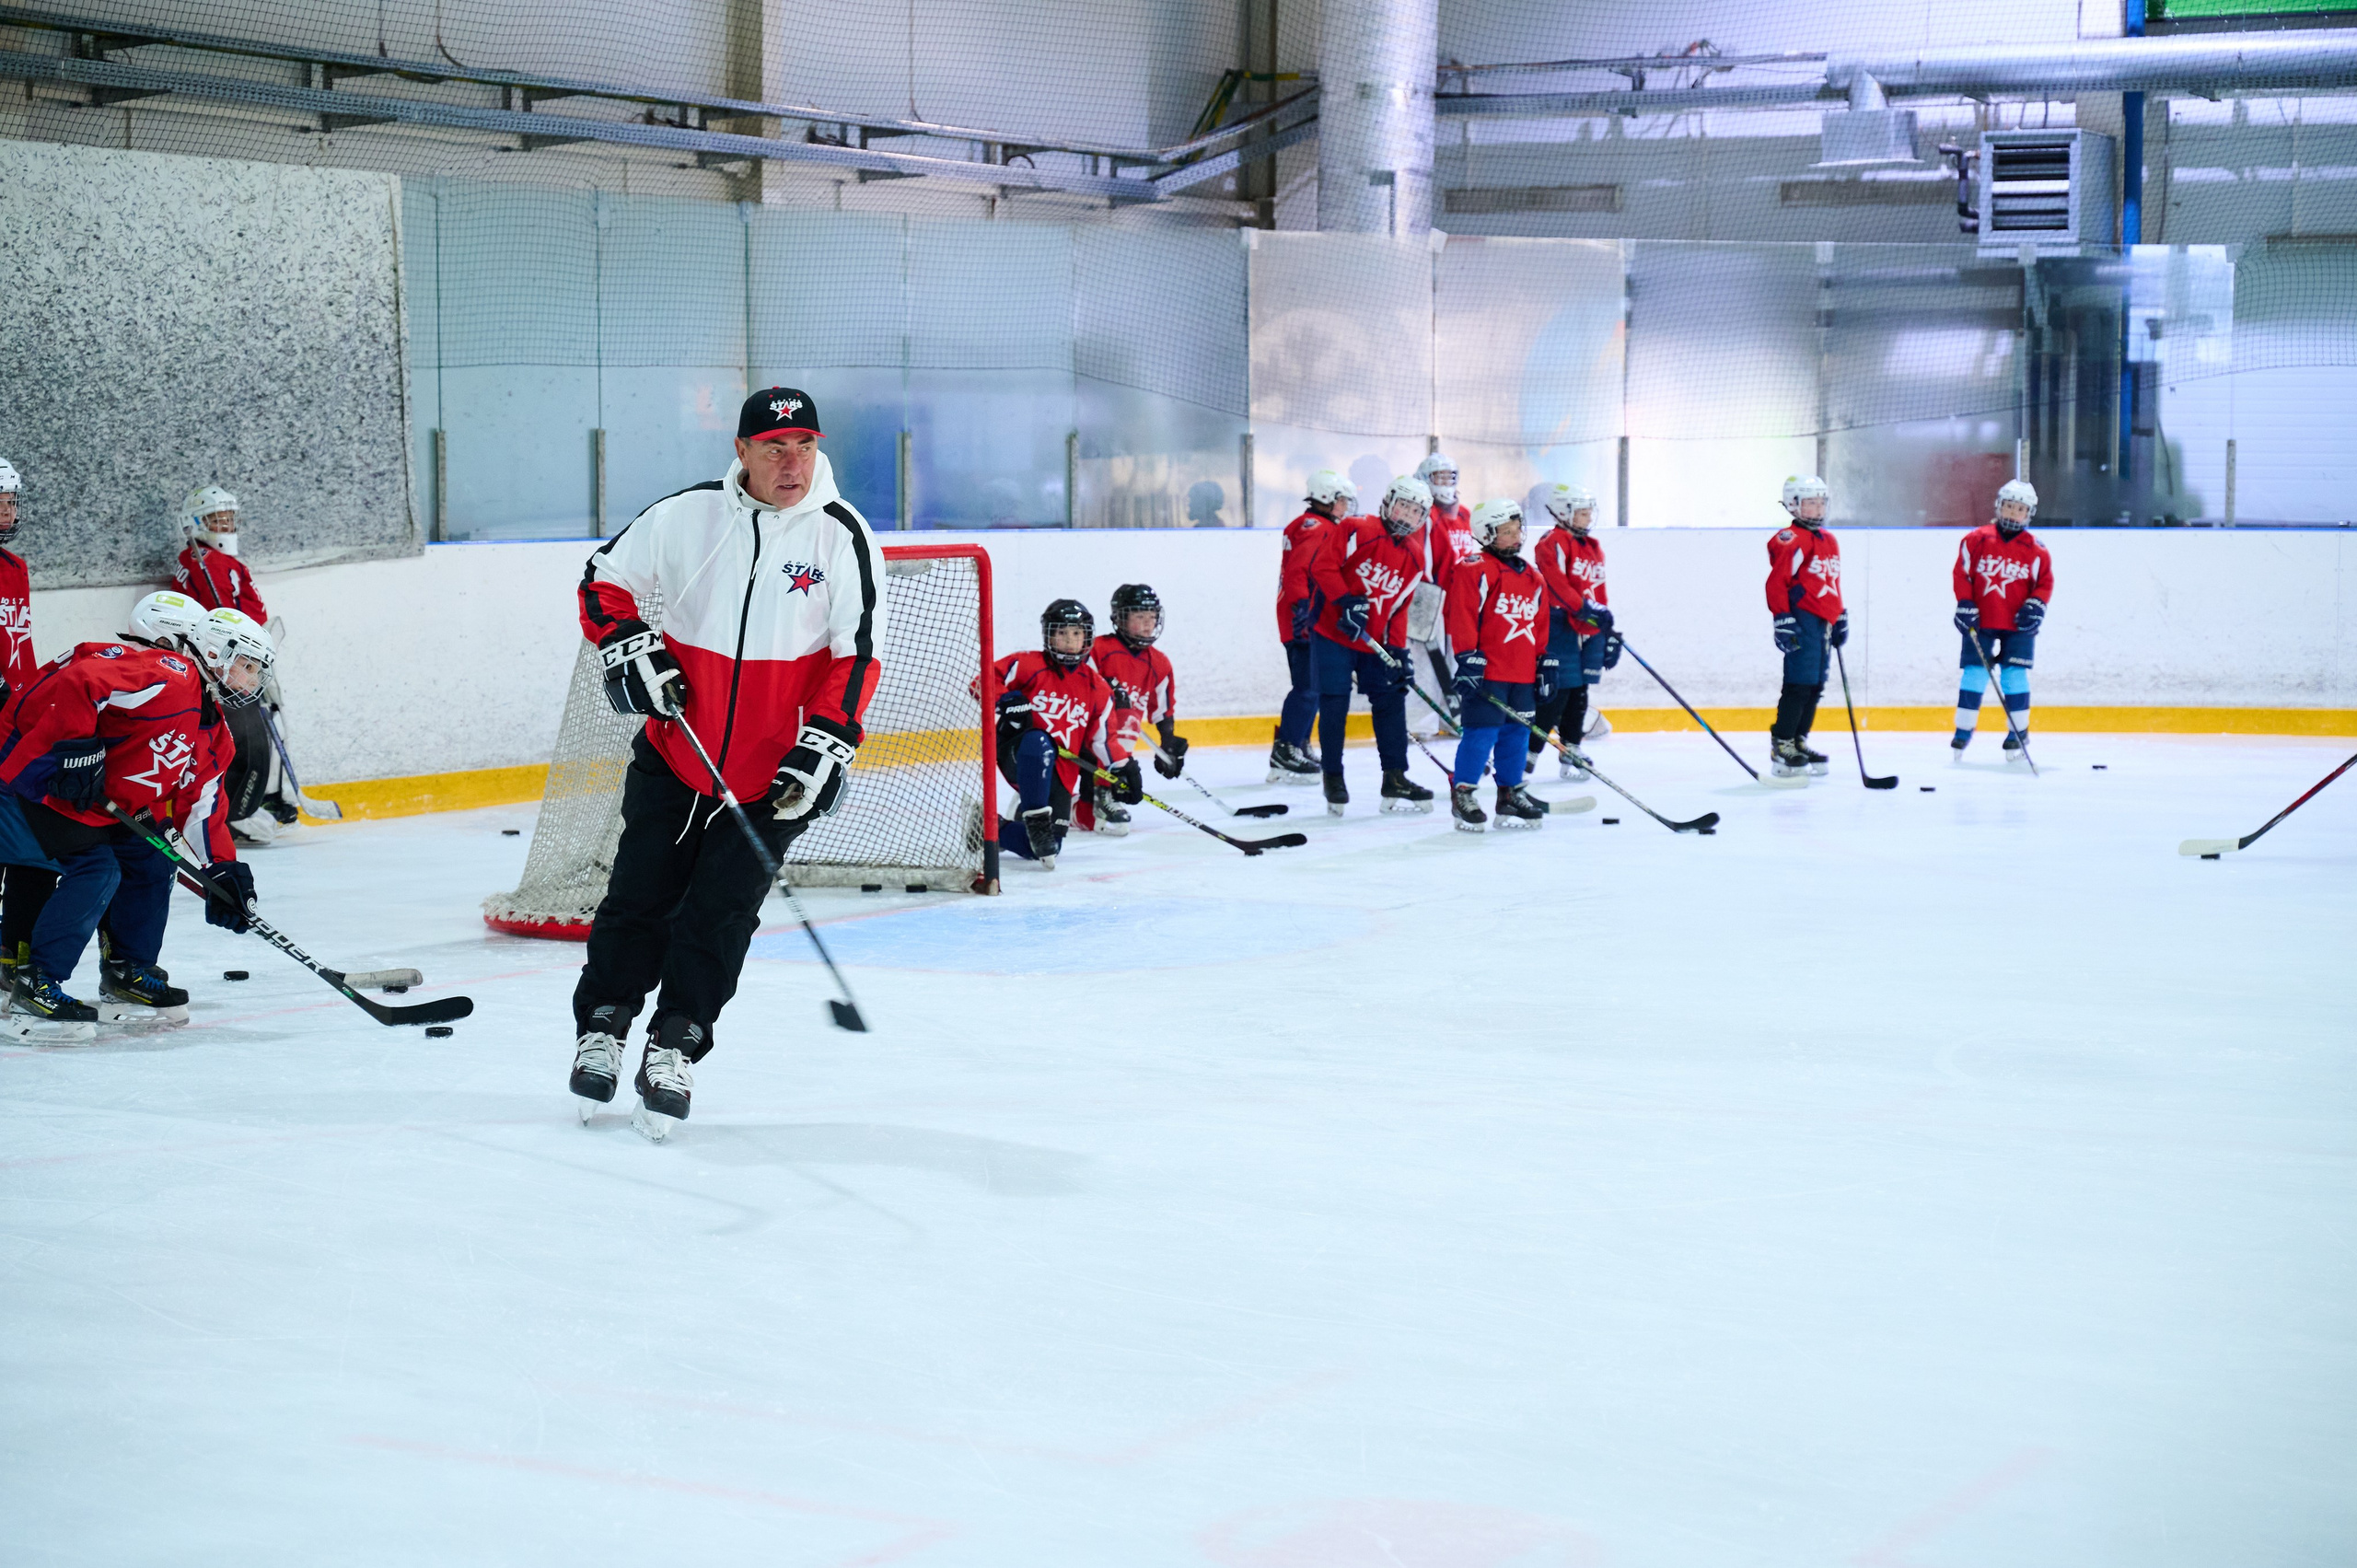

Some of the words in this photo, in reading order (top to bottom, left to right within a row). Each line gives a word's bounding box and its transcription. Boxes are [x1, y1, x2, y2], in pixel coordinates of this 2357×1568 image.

[782, 563, 825, 581] STARS
[1977, 558, 2029, 579] STARS
[602, 633, 664, 667] CCM
